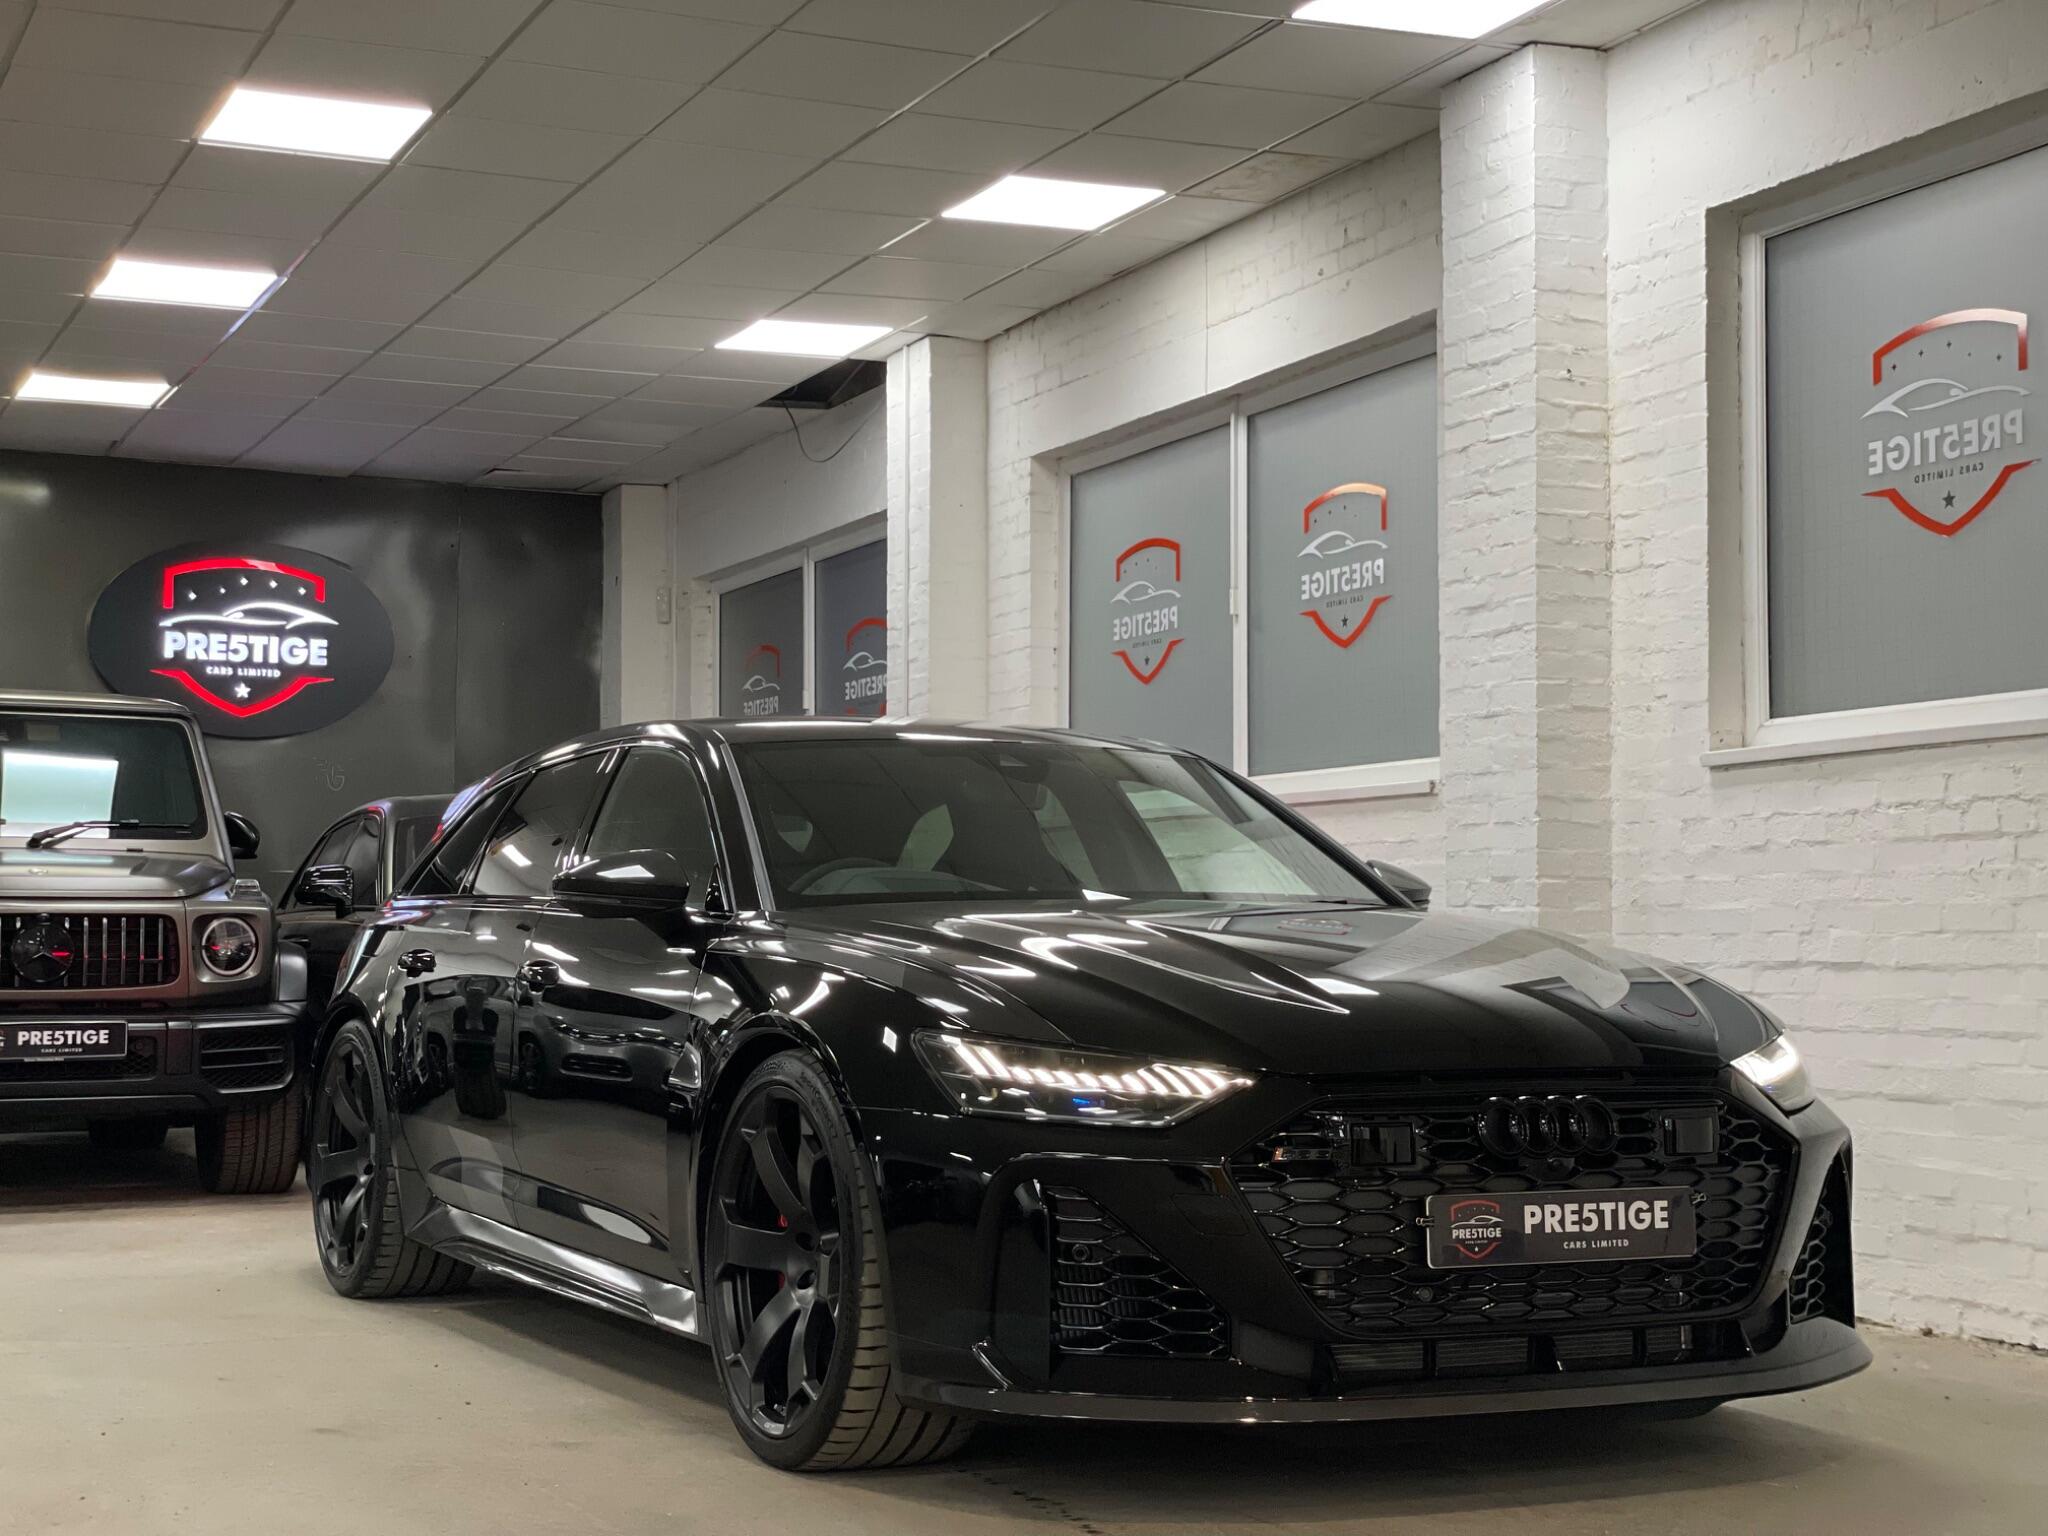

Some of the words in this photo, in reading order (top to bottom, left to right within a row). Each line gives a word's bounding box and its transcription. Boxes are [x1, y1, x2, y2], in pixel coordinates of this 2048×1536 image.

[206, 666, 233, 676] CARS
[237, 667, 281, 678] LIMITED
[1563, 1240, 1587, 1249] CARS
[1591, 1239, 1629, 1248] LIMITED
